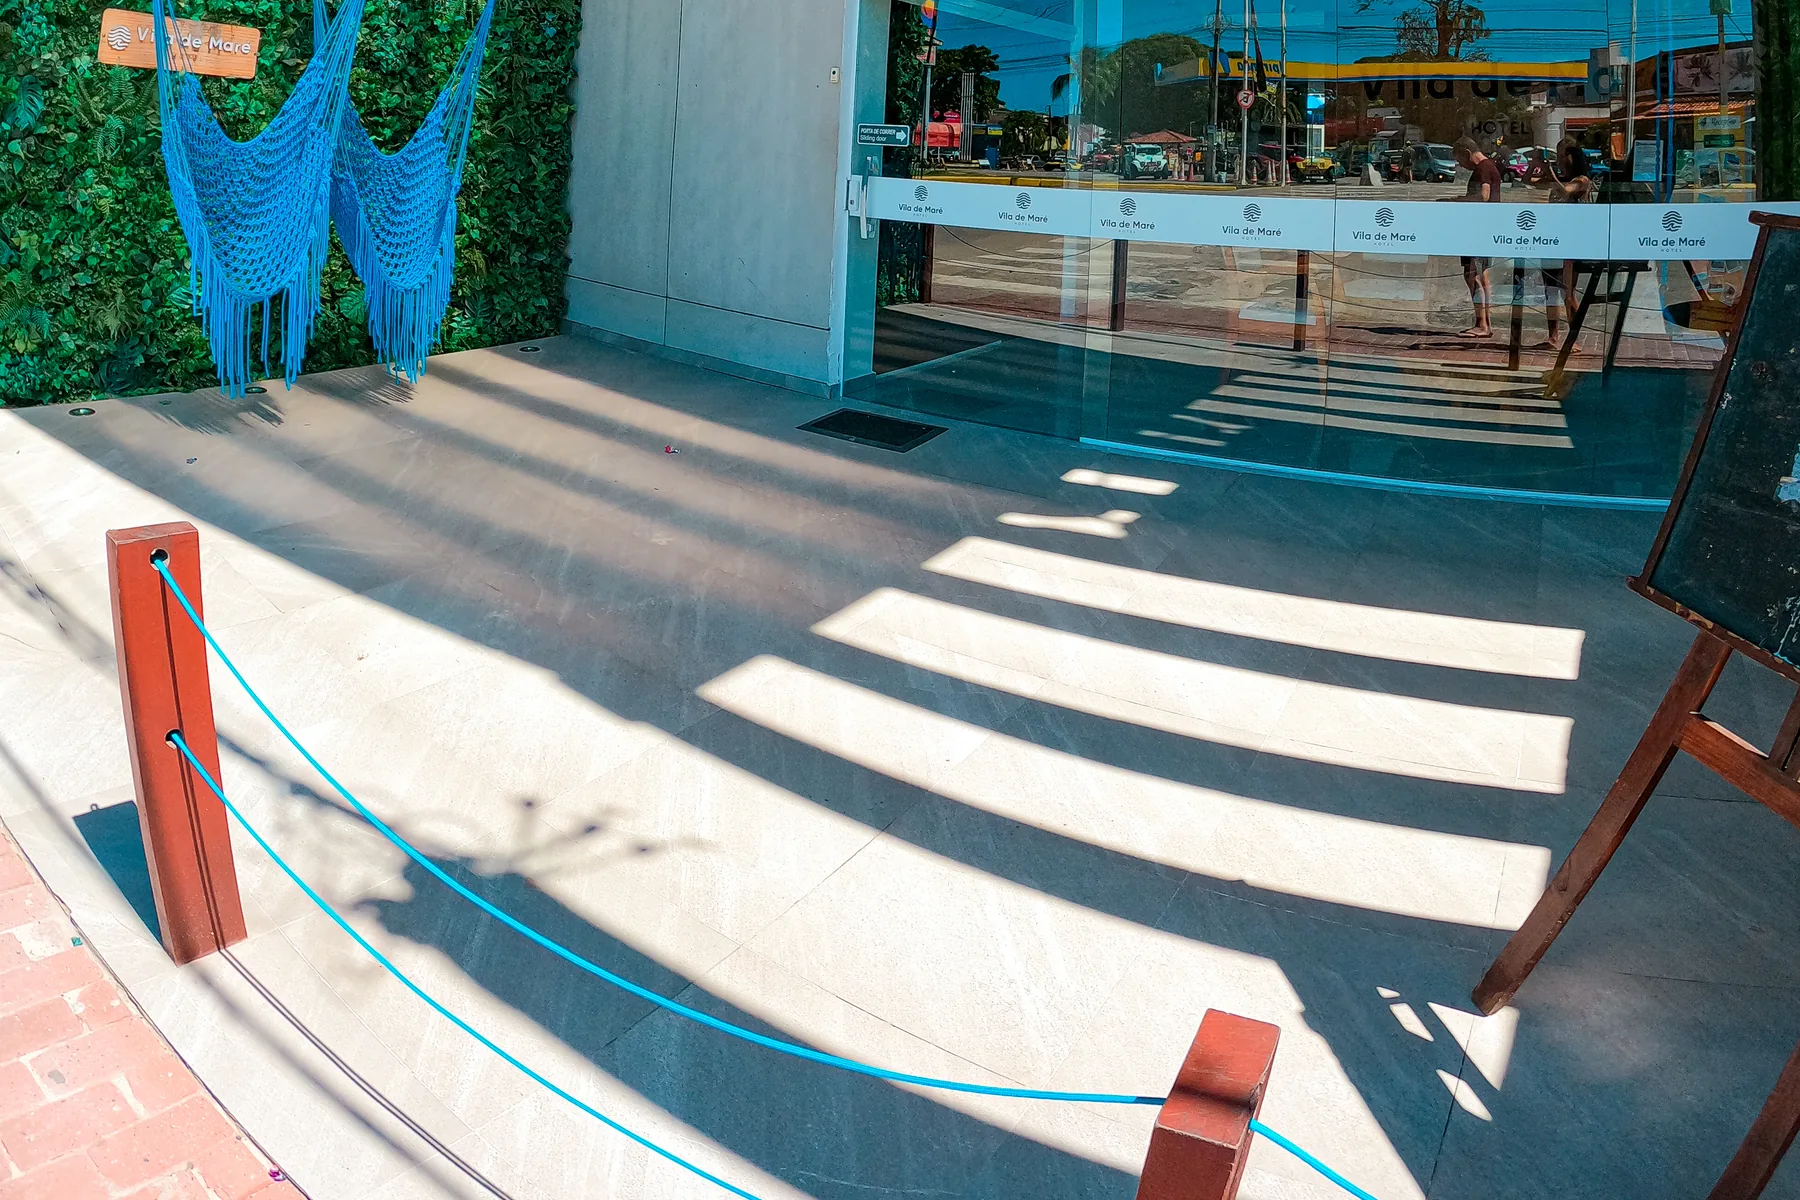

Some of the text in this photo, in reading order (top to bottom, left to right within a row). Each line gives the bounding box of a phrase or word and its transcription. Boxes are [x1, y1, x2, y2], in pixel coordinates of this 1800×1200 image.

[181, 33, 202, 49] de
[209, 36, 251, 55] Maré
[1471, 120, 1530, 136] HOTEL
[860, 134, 876, 142] Sliding
[898, 203, 944, 215] Vila de Maré
[998, 212, 1048, 223] Vila de Maré
[1100, 219, 1156, 230] Vila de Maré
[1222, 226, 1282, 237] Vila de Maré
[1352, 231, 1417, 242] Vila de Maré
[1492, 235, 1560, 246] Vila de Maré
[1638, 236, 1706, 247] Vila de Maré
